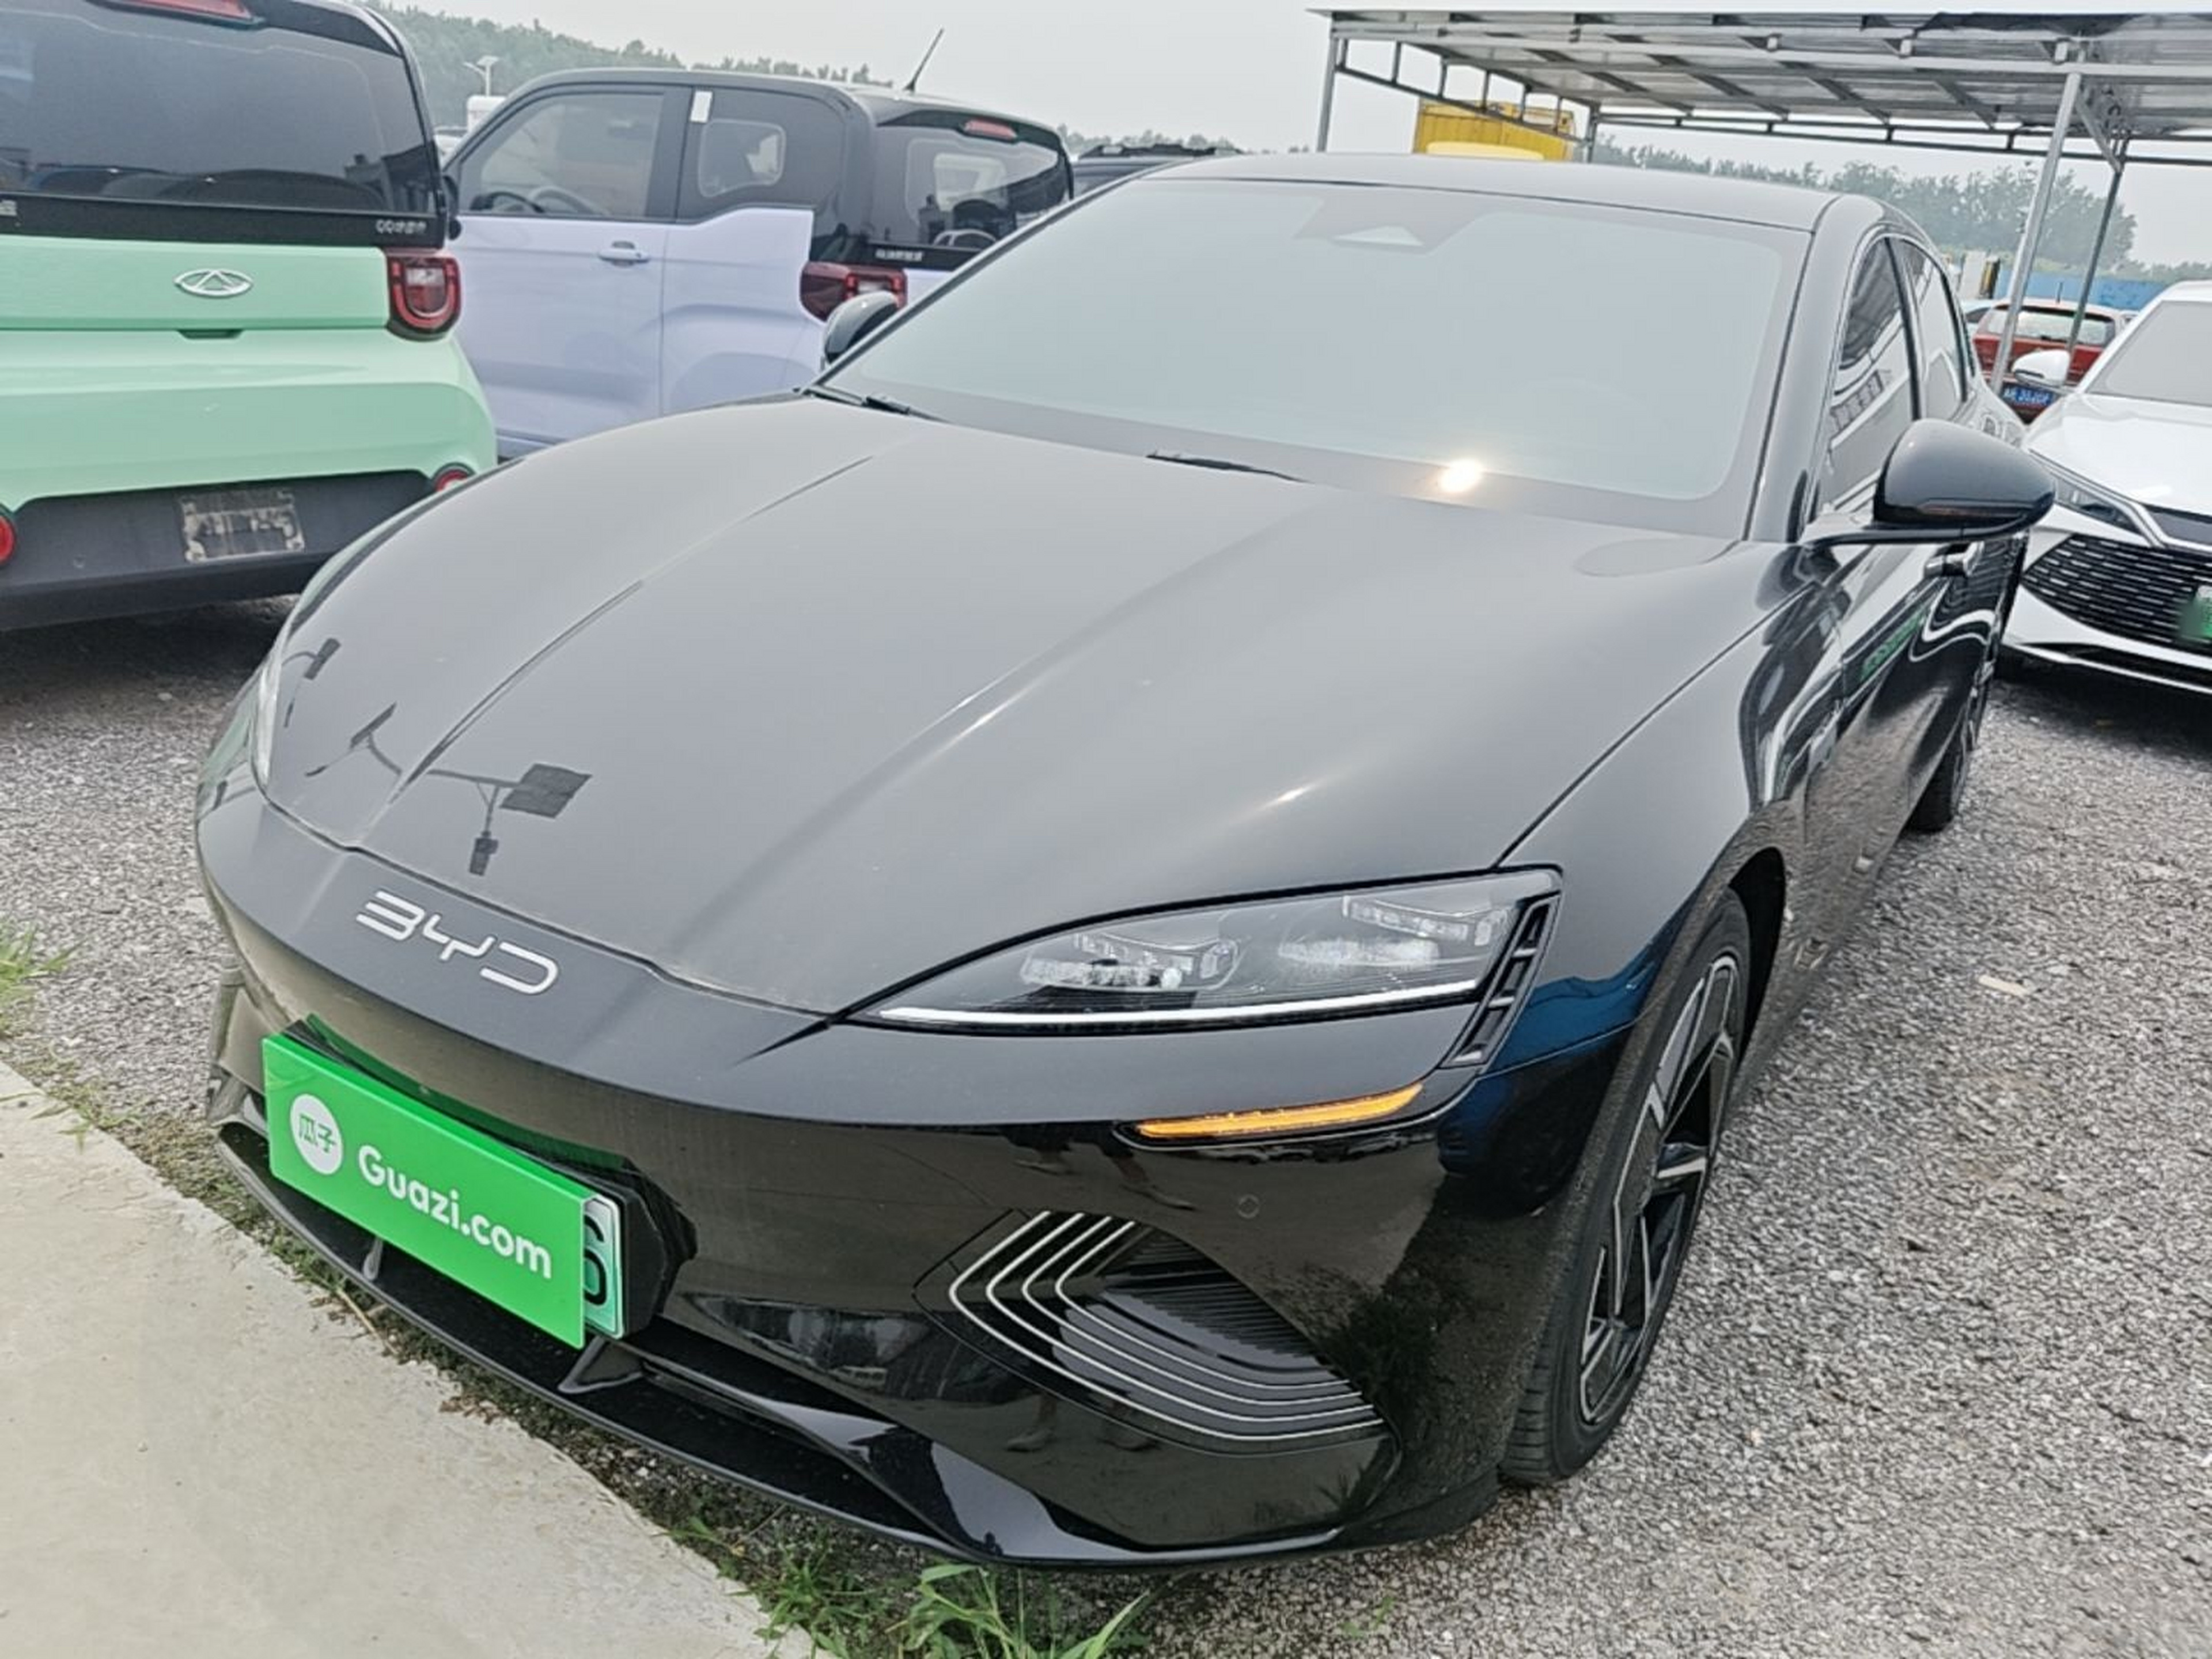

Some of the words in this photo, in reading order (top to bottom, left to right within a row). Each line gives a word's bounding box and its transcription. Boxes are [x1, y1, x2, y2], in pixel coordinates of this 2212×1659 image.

[356, 891, 558, 994] BYD
[299, 1113, 336, 1153] 瓜子
[358, 1145, 552, 1279] Guazi.com
